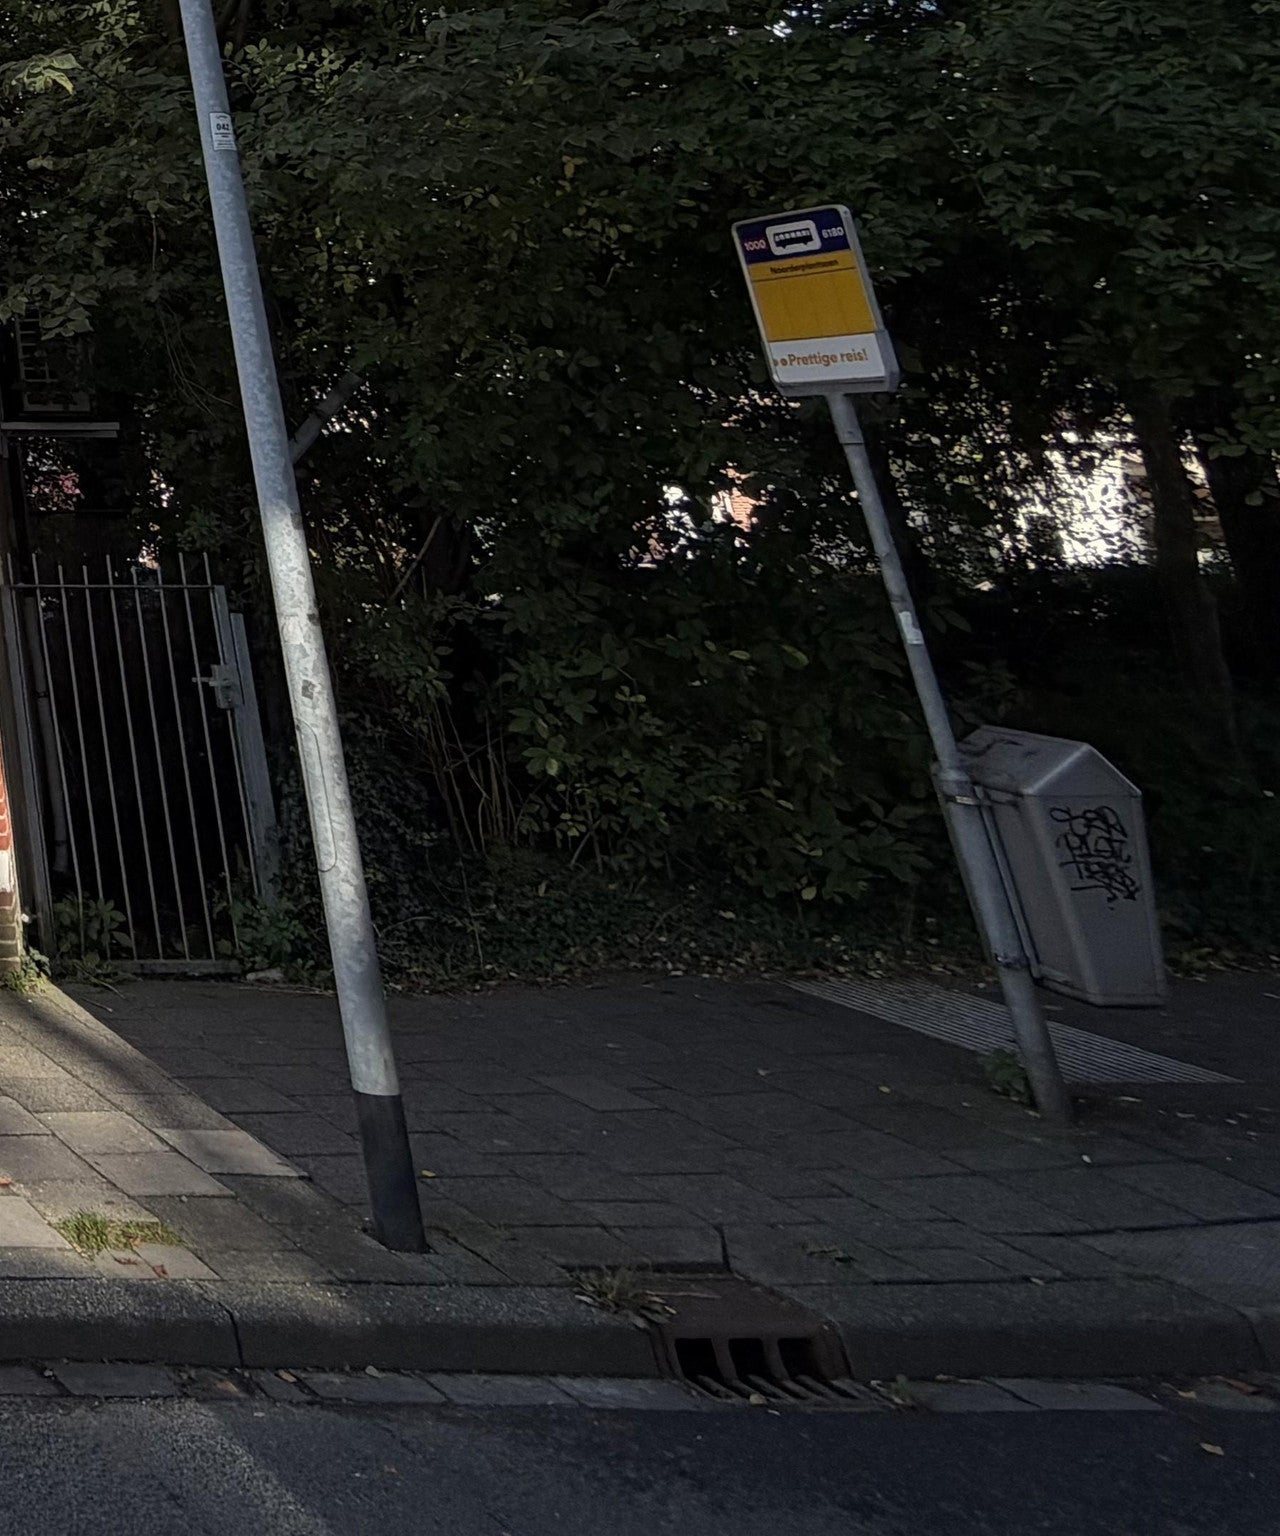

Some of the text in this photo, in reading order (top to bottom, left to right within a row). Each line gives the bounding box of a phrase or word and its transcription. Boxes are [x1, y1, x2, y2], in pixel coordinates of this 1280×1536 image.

[744, 239, 767, 251] 1000
[787, 348, 868, 367] Prettige reis!
